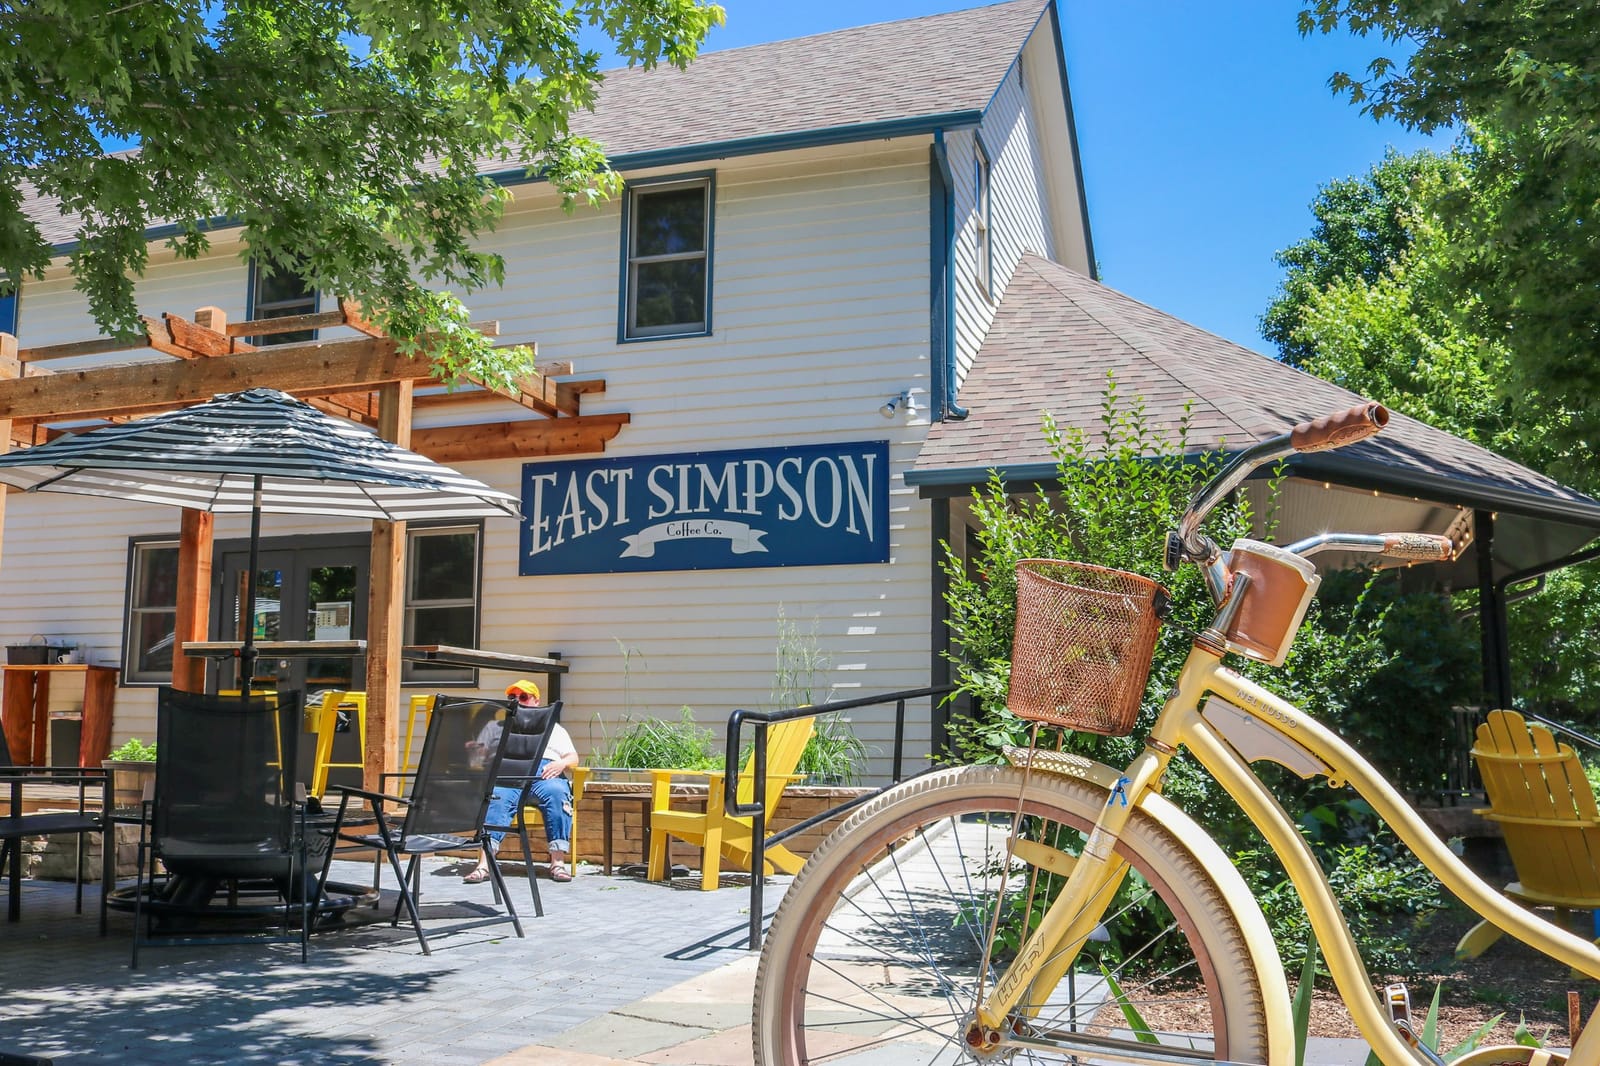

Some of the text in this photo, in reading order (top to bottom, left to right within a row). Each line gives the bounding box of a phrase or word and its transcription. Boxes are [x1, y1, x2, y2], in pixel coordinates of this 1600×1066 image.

[529, 453, 877, 556] EAST SIMPSON
[666, 521, 722, 537] Coffee Co.
[1236, 688, 1297, 728] NEL LUSSO
[997, 932, 1045, 1007] HUFFY
